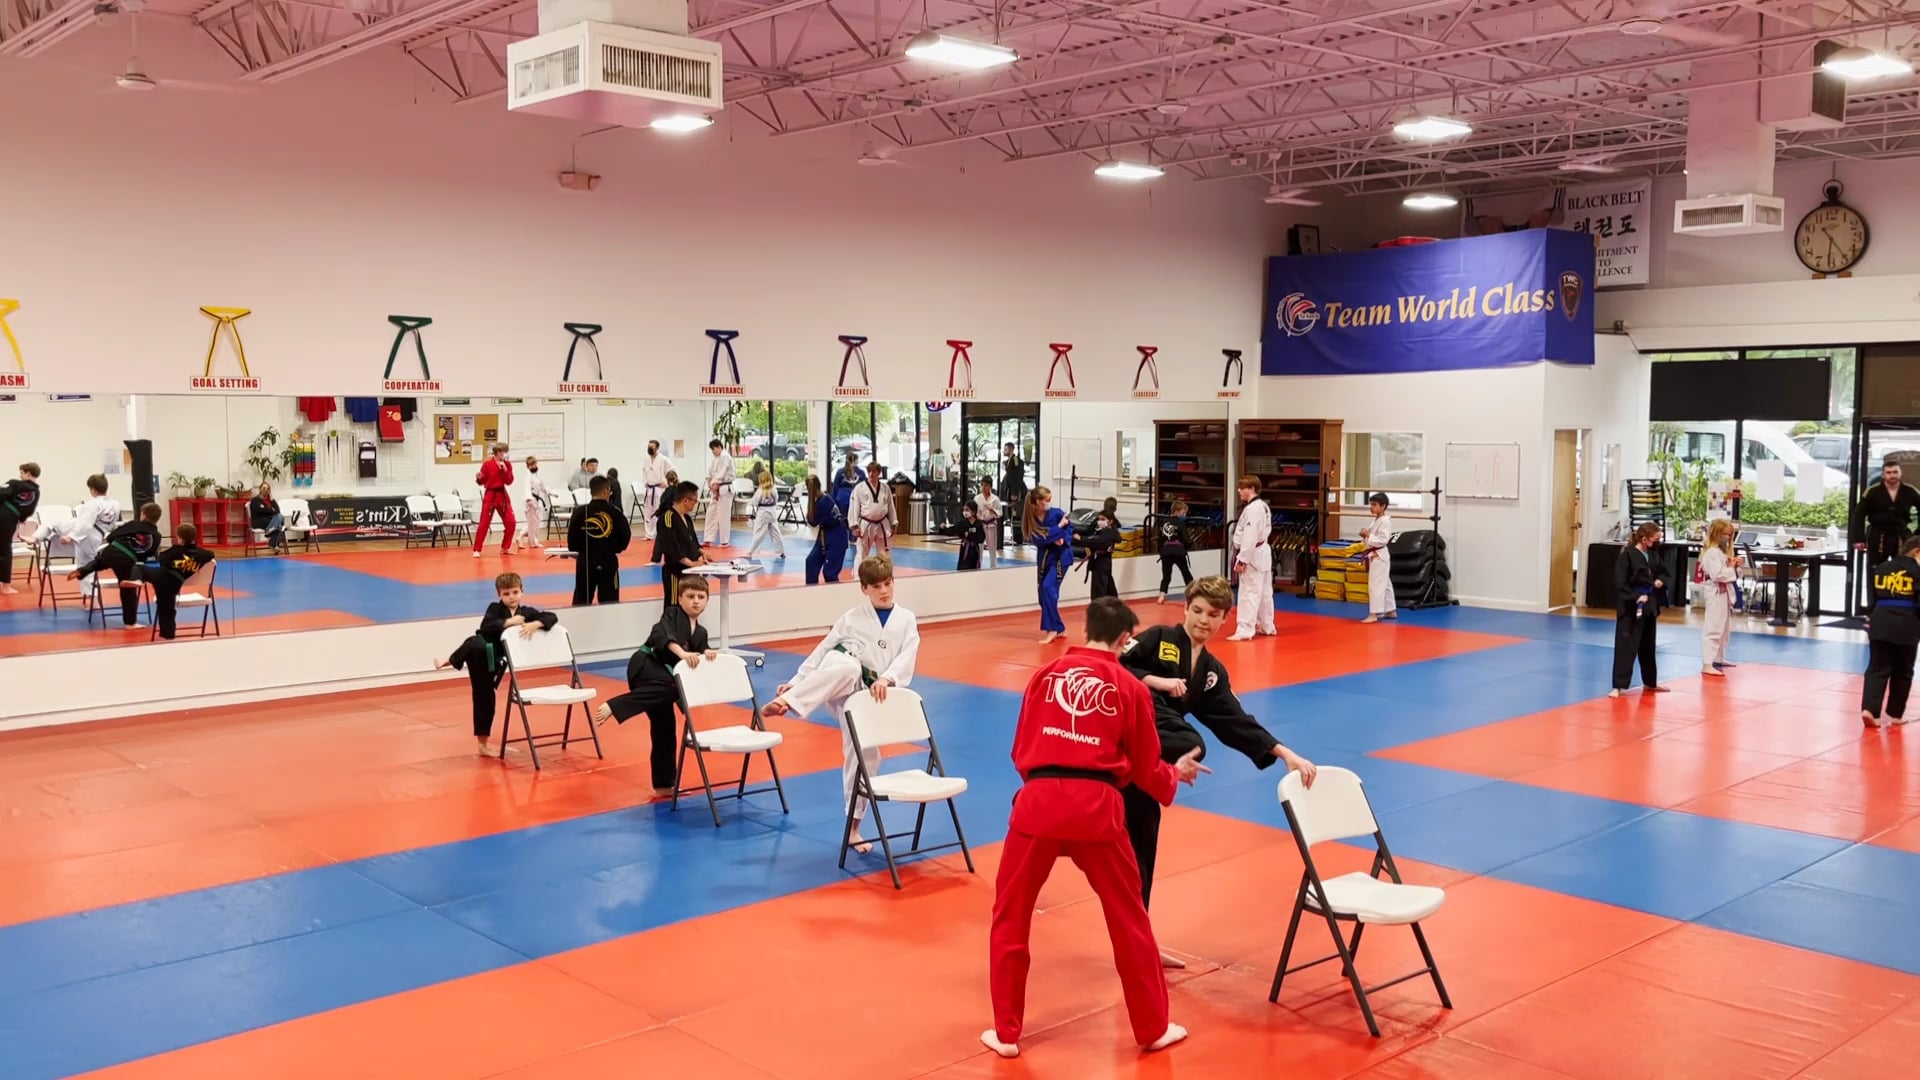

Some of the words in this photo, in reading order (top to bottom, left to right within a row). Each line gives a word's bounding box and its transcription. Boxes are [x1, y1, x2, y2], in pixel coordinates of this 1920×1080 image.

[1568, 194, 1608, 210] BLACK
[1611, 190, 1645, 206] BELT
[1598, 259, 1611, 267] TO
[1324, 302, 1392, 328] Team
[1398, 288, 1477, 324] World
[1482, 282, 1555, 316] Class
[192, 377, 216, 388] GOAL
[219, 378, 258, 388] SETTING
[384, 381, 440, 391] COOPERATION
[559, 384, 575, 393] SELF
[576, 384, 608, 393] CONTROL
[701, 386, 744, 395] PERSEVERANCE
[834, 388, 869, 396] CONFIDENCE
[1043, 671, 1117, 716] TWC
[1042, 726, 1101, 746] PERFORMANCE
